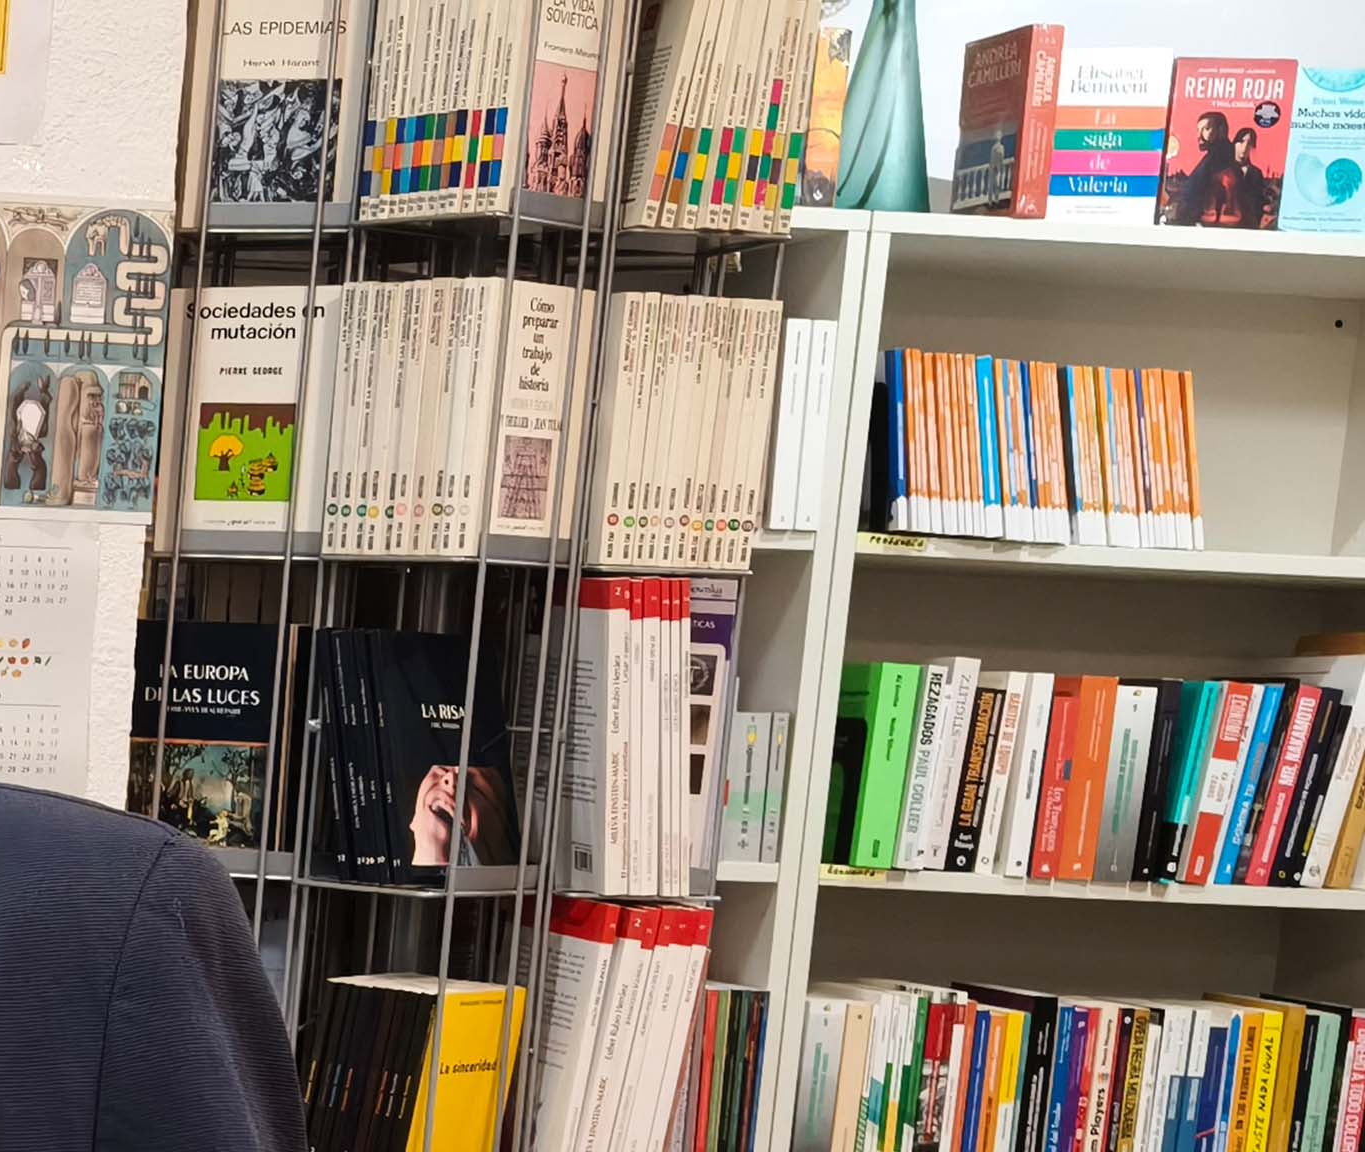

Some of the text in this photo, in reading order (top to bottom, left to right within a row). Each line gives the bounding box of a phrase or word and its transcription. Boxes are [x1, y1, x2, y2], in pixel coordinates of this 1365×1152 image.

[259, 20, 347, 35] EPIDEMIAS
[1184, 76, 1285, 101] REINA ROJA
[1094, 109, 1117, 126] La
[1082, 133, 1123, 152] saga
[1090, 156, 1110, 172] de
[1068, 175, 1128, 195] Valeria
[187, 302, 296, 319] Sociedades
[530, 297, 555, 314] Cómo
[211, 323, 296, 340] mutación
[522, 315, 559, 330] preparar
[533, 333, 544, 344] un
[522, 346, 552, 364] trabajo
[219, 367, 283, 376] PIERRE GEORGE
[530, 362, 541, 376] de
[519, 376, 549, 392] historia
[183, 663, 250, 682] EUROPA
[172, 688, 261, 706] LAS LUCES
[421, 703, 466, 721] LA RISA
[920, 671, 944, 745] REZAGADOS
[1285, 697, 1316, 762] NAKAMOTO
[907, 749, 931, 835] PAUL COLLIER
[1262, 1036, 1275, 1073] IGUAL
[439, 1058, 497, 1075] La sinceridad
[1257, 1077, 1271, 1111] NADA
[1090, 1087, 1106, 1137] Players
